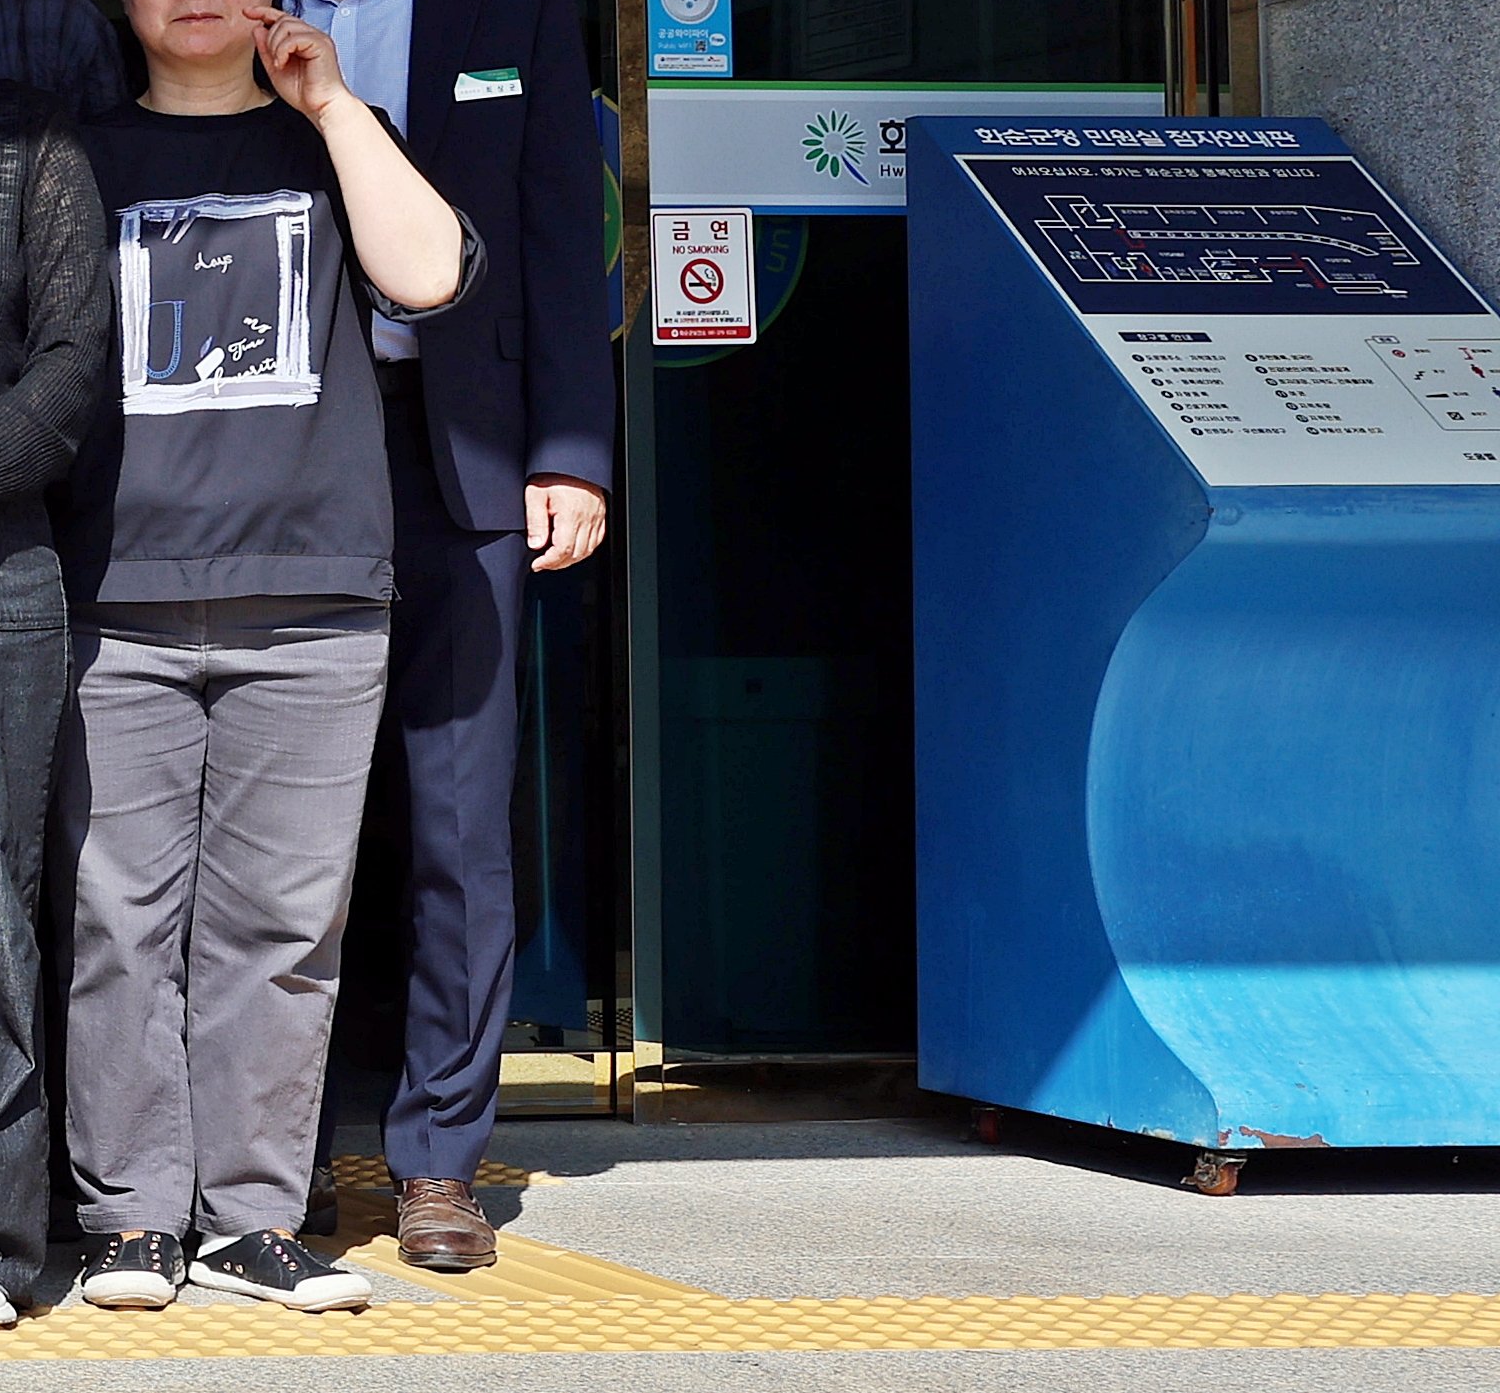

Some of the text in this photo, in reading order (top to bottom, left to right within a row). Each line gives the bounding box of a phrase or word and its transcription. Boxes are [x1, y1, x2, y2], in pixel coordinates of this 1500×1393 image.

[974, 128, 1300, 148] 화순군청 민원실 점자안내판
[672, 245, 729, 254] NO SMOKING
